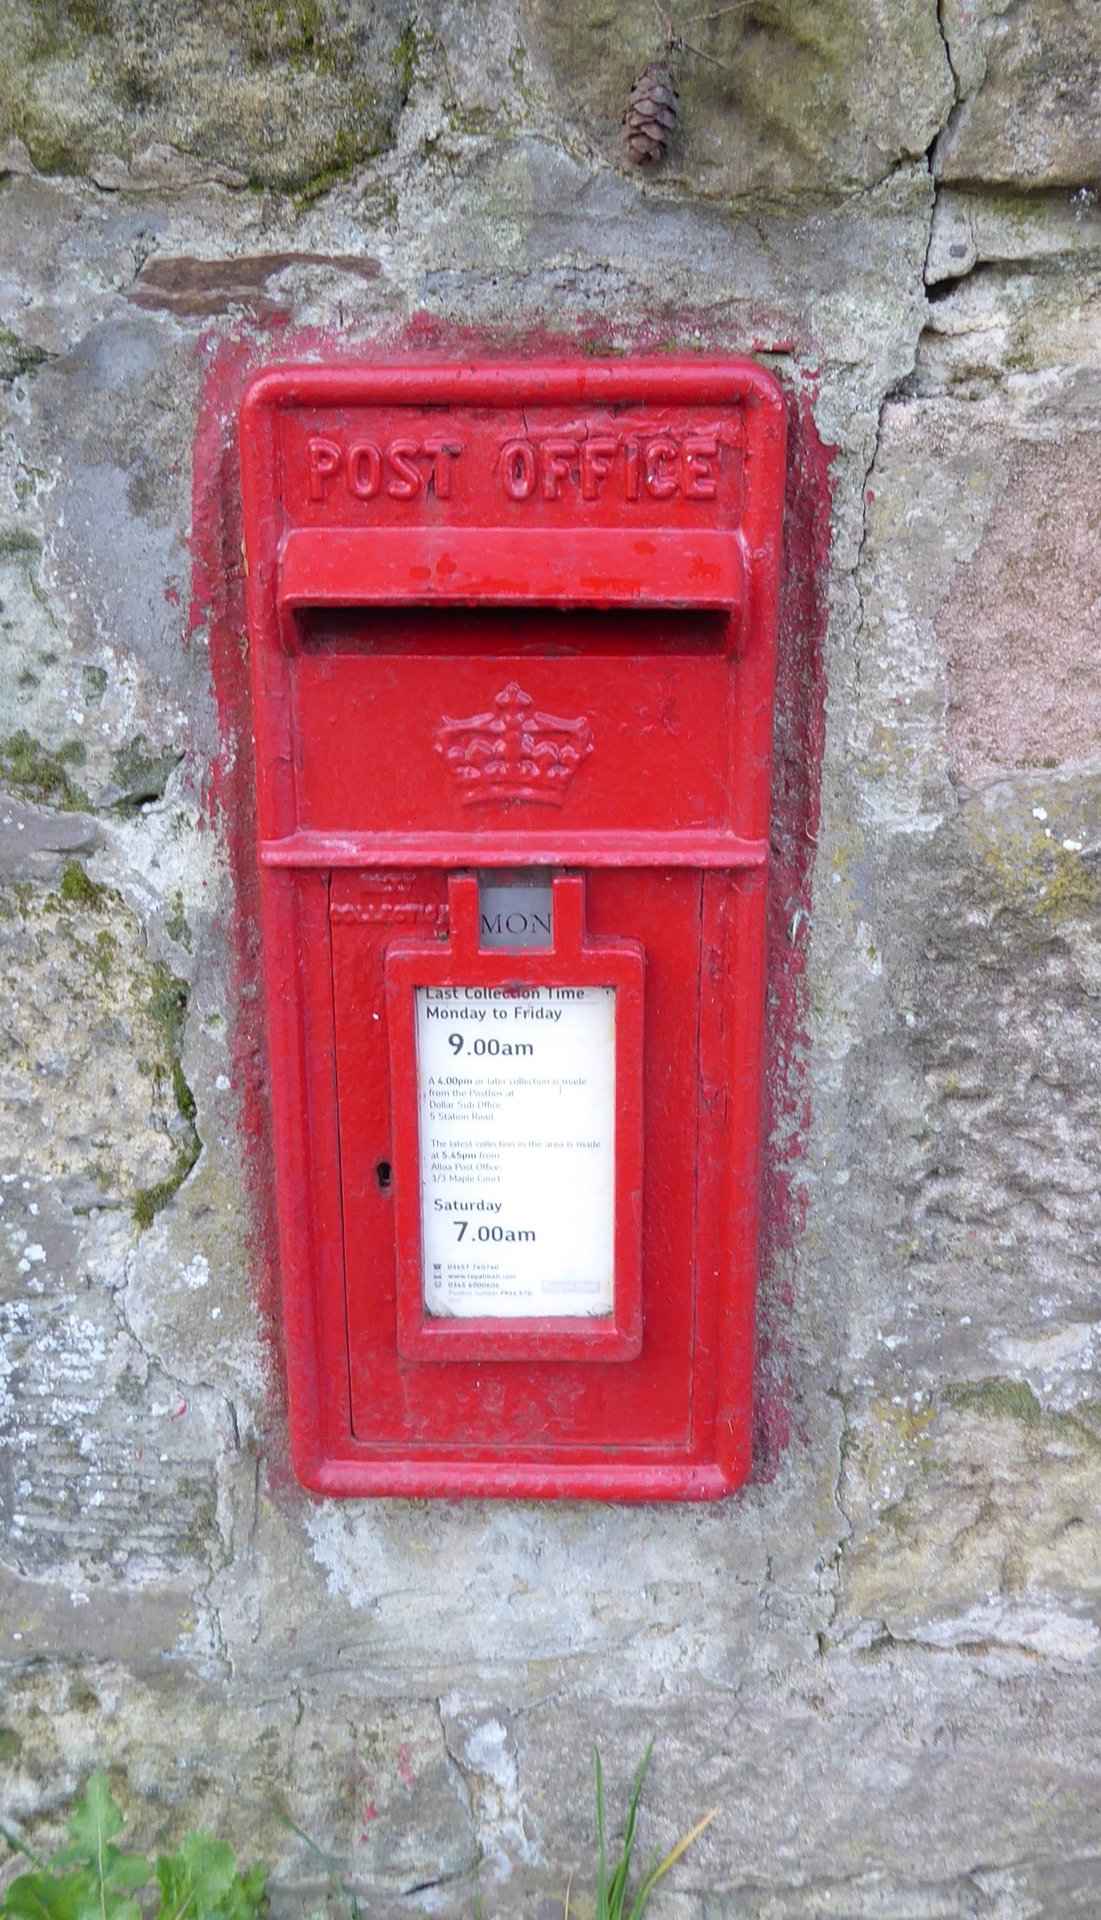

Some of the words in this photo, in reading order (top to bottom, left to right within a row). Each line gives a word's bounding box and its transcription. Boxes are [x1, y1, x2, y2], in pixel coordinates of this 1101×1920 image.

[307, 437, 467, 499] POST
[499, 437, 719, 499] OFFICE
[481, 912, 551, 935] MON
[426, 986, 459, 999] Last
[464, 986, 540, 999] Collection
[426, 1007, 486, 1022] Monday
[493, 1007, 507, 1019] to
[514, 1007, 562, 1022] Friday
[448, 1033, 534, 1056] 9.00am
[428, 1076, 435, 1085] A
[438, 1076, 473, 1086] 4.00pm
[487, 1077, 505, 1085] later
[509, 1077, 549, 1085] collection
[562, 1077, 587, 1085] made
[429, 1100, 454, 1109] Dollar
[458, 1101, 474, 1109] Sub
[439, 1112, 469, 1120] Station
[472, 1112, 493, 1120] Road
[431, 1139, 447, 1147] The
[442, 1151, 476, 1160] 5.45pm
[449, 1174, 474, 1183] Maple
[477, 1174, 500, 1182] Court
[434, 1199, 502, 1213] Saturday
[453, 1221, 536, 1242] 7.00am
